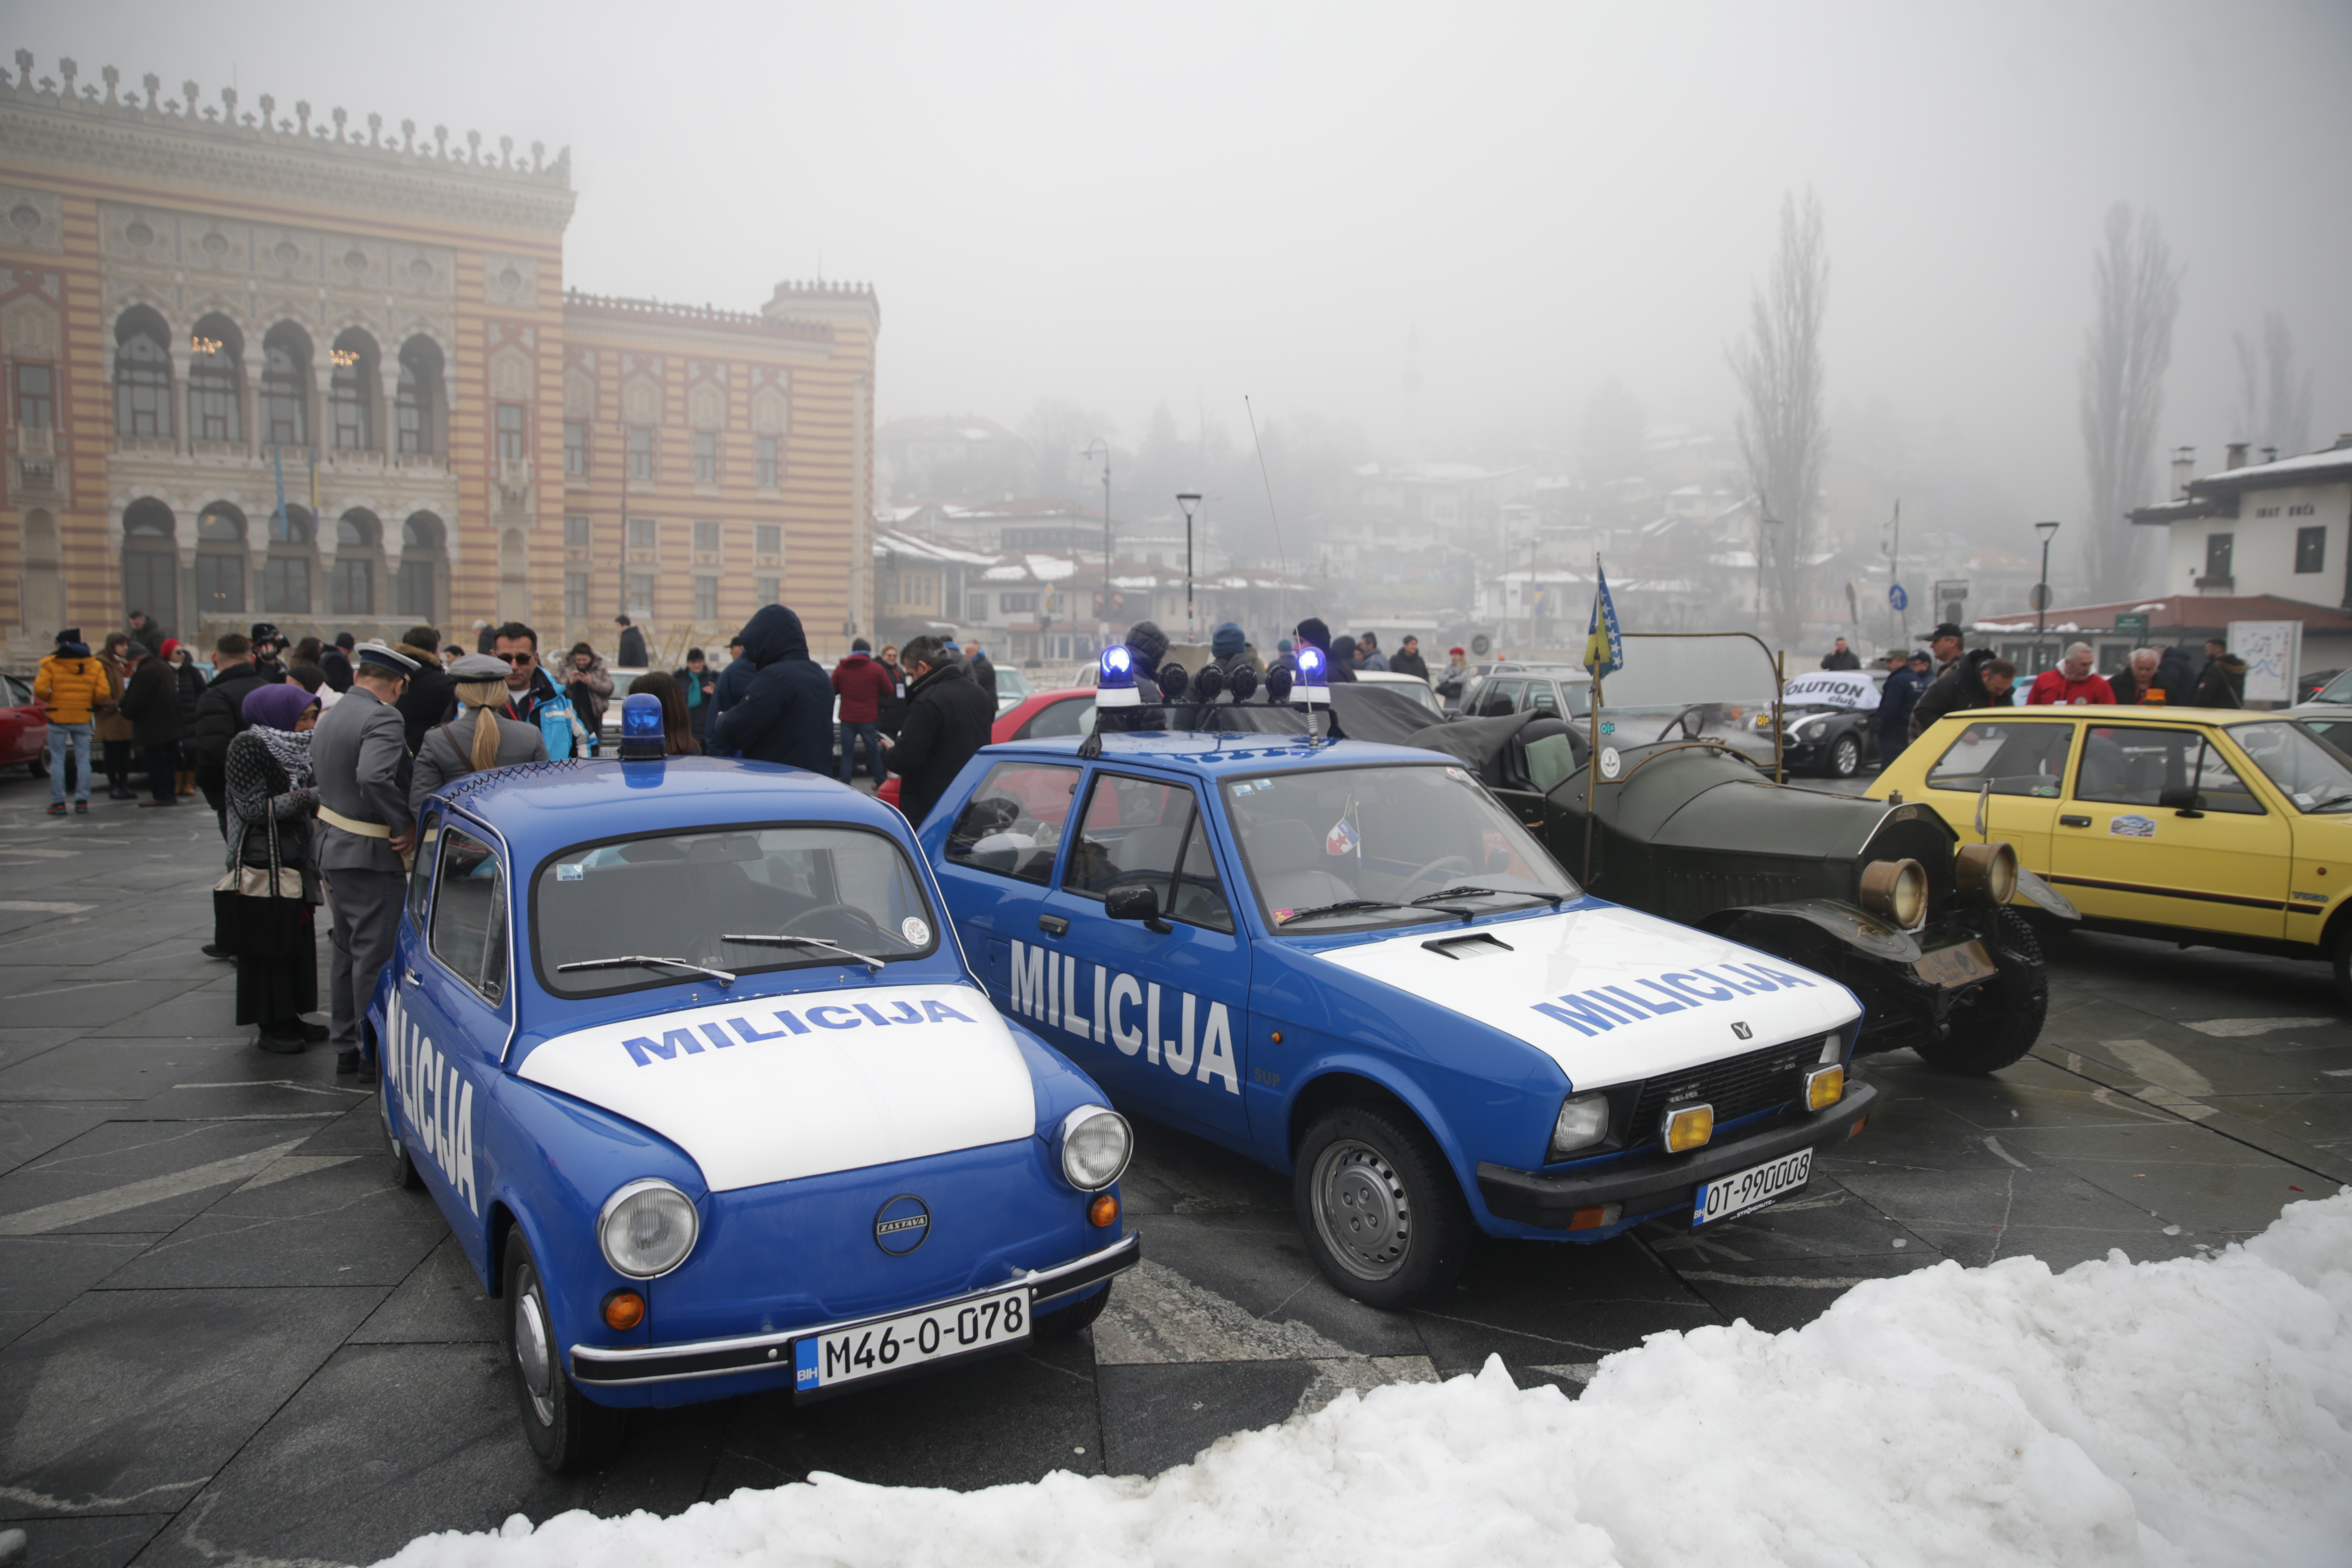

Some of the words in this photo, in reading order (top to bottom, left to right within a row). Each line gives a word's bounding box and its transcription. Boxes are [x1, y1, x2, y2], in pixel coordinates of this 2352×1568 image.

[1784, 681, 1865, 697] OLUTION
[1828, 694, 1856, 706] club
[1529, 963, 1818, 1037] MILICIJA
[1011, 939, 1240, 1095] MILICIJA
[621, 1000, 979, 1067] MILICIJA
[1254, 1067, 1280, 1088] SUP
[1694, 1207, 1705, 1219] BIH
[880, 1218, 925, 1232] ZASTAVA
[797, 1367, 818, 1382] BIH
